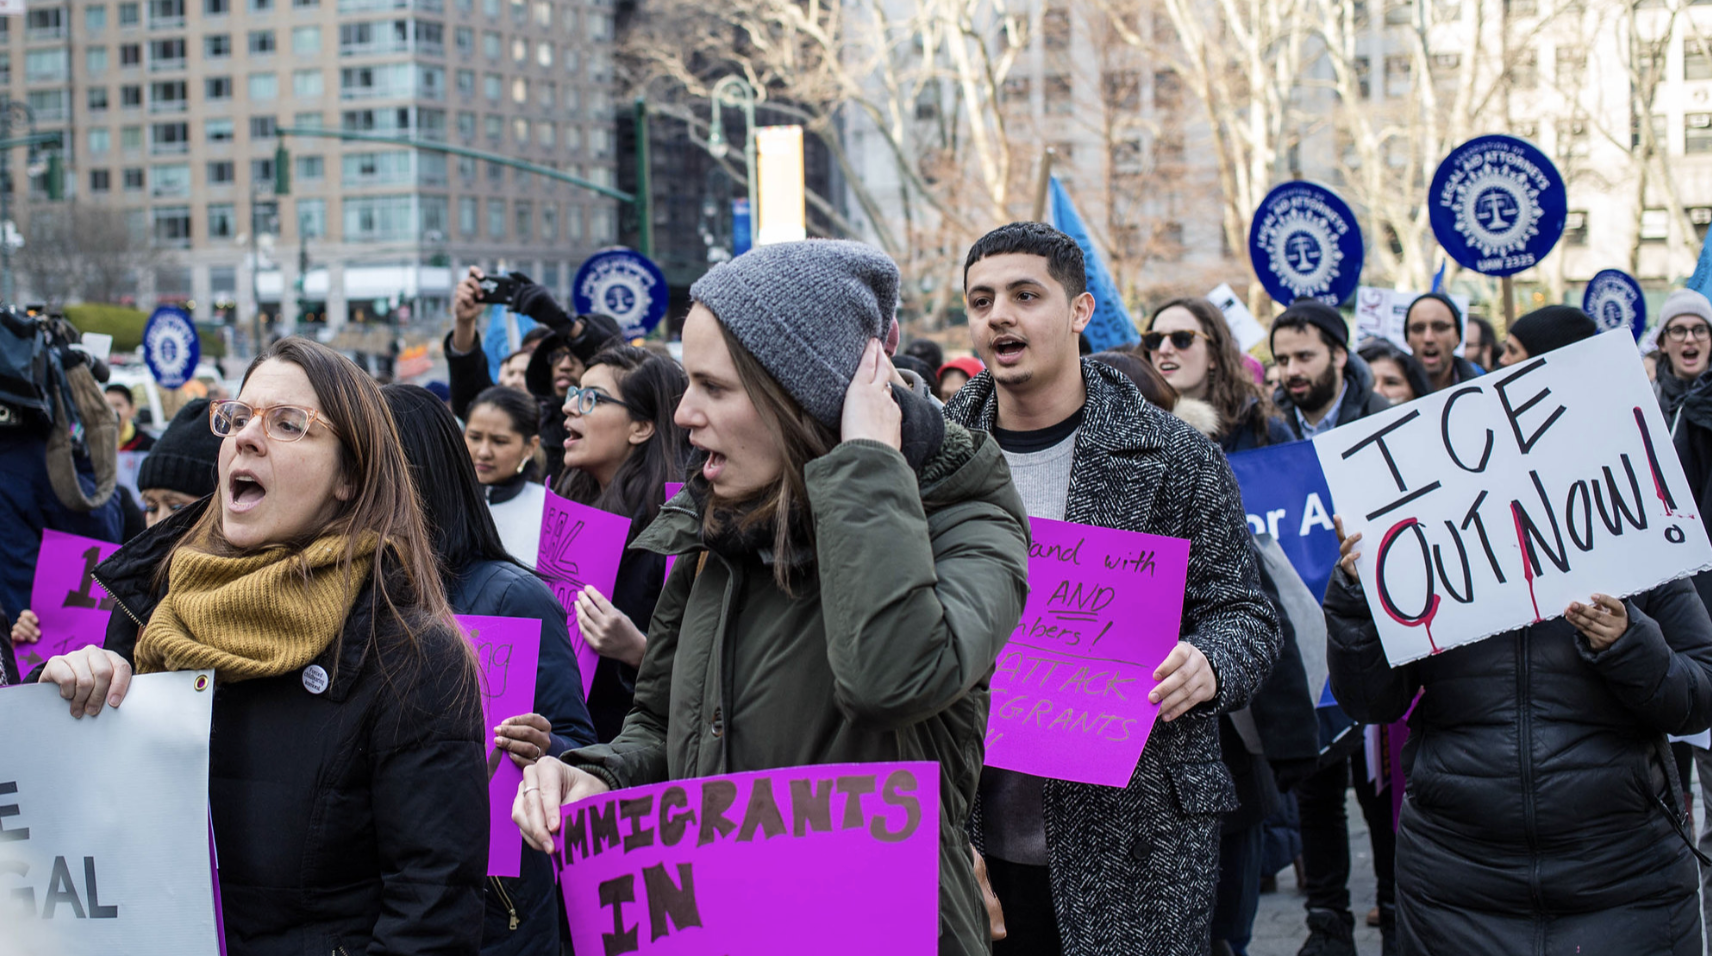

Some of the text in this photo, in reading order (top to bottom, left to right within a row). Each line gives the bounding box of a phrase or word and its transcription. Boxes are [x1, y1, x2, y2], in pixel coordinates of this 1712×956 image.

[1440, 150, 1551, 207] LEGAL AID ATTORNEYS
[1341, 357, 1567, 521] ICE
[1376, 406, 1687, 627] OUT NOW!
[1028, 537, 1156, 577] and with
[1047, 579, 1116, 613] AND
[470, 628, 514, 698] ng
[996, 651, 1137, 700] ATTACK
[990, 688, 1138, 742] GRANTS
[598, 861, 703, 956] IN
